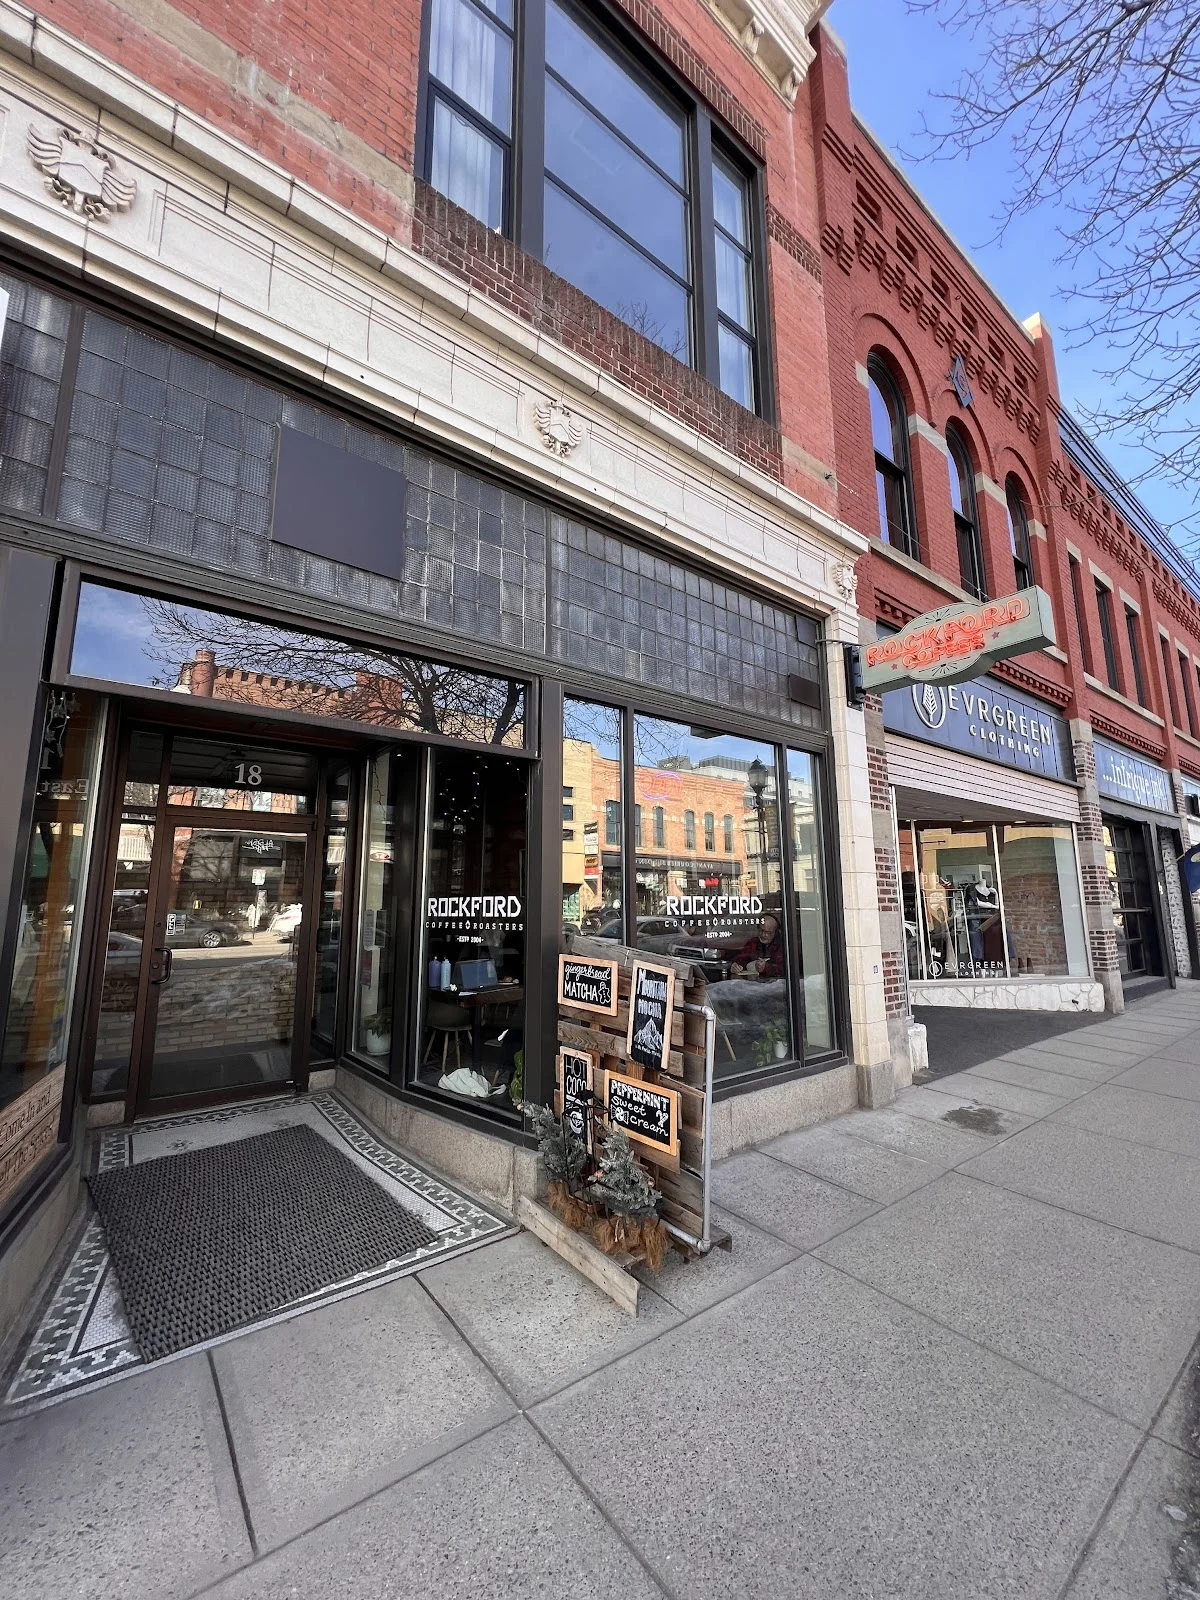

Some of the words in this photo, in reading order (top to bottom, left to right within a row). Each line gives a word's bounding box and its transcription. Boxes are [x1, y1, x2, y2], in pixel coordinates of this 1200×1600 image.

[866, 598, 1024, 667] ROCKFORD
[902, 633, 985, 669] COFFEE
[948, 685, 1051, 746] EVRGREEN
[969, 724, 1040, 757] CLOTHING
[234, 763, 262, 786] 18
[427, 895, 522, 918] ROCKFORD
[666, 895, 763, 916] ROCKFORD
[425, 921, 463, 930] COFFEE
[473, 922, 524, 931] ROASTERS
[664, 919, 711, 928] COFFEE
[720, 917, 766, 926] ROASTERS
[564, 963, 611, 981] gingerbread
[944, 960, 1004, 970] EVRGREEN
[564, 980, 599, 1002] MATCHA
[637, 998, 662, 1019] MOCHA
[565, 1056, 588, 1080] HOT
[610, 1079, 670, 1112] PEPPERMINT
[611, 1095, 647, 1116] Sweet
[629, 1115, 669, 1137] cream
